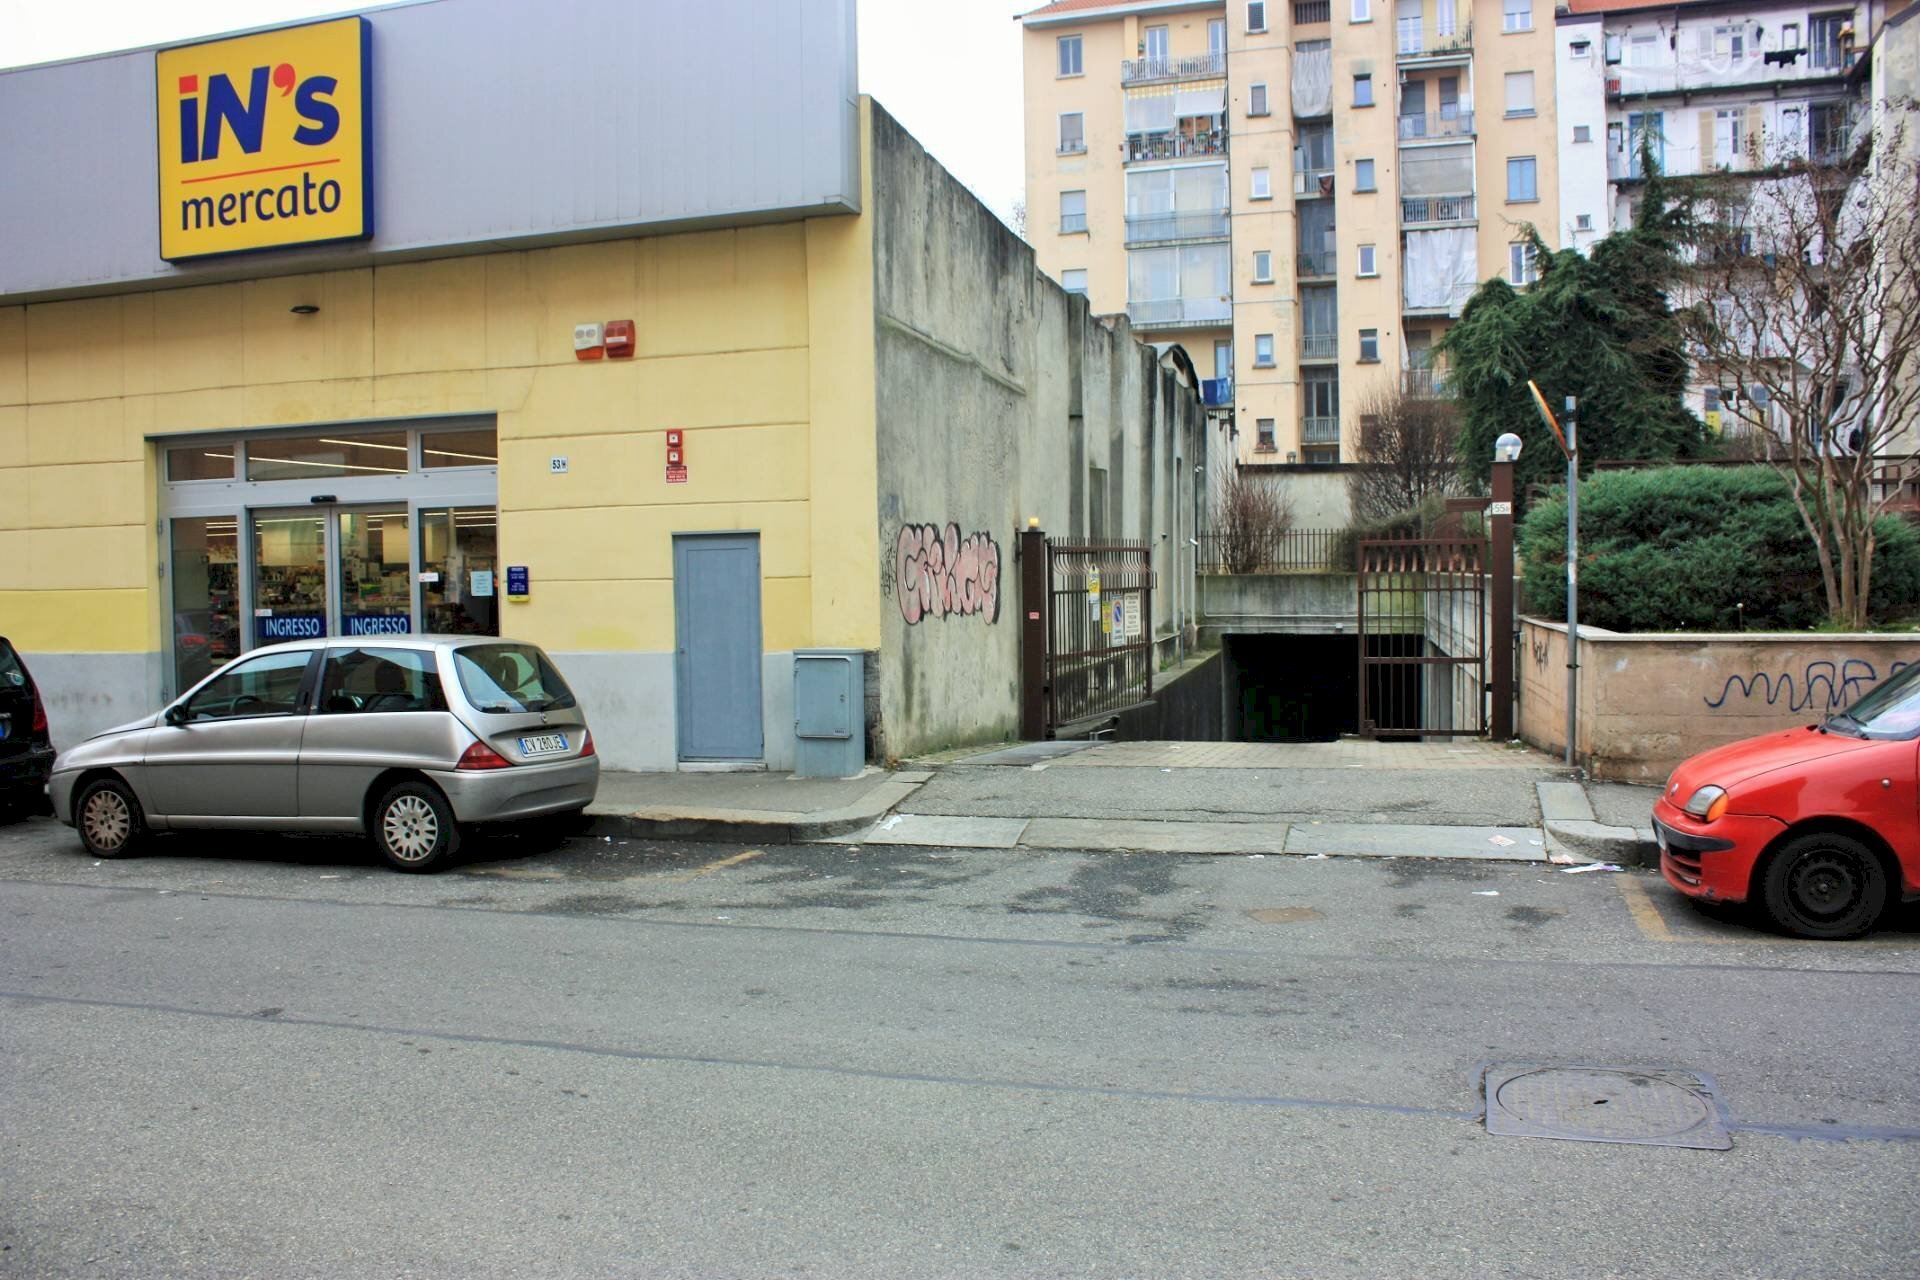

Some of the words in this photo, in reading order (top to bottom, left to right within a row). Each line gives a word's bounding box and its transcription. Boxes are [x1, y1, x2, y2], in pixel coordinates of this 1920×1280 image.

[181, 172, 341, 231] mercato
[265, 617, 320, 636] INGRESSO
[351, 617, 408, 635] INGRESSO
